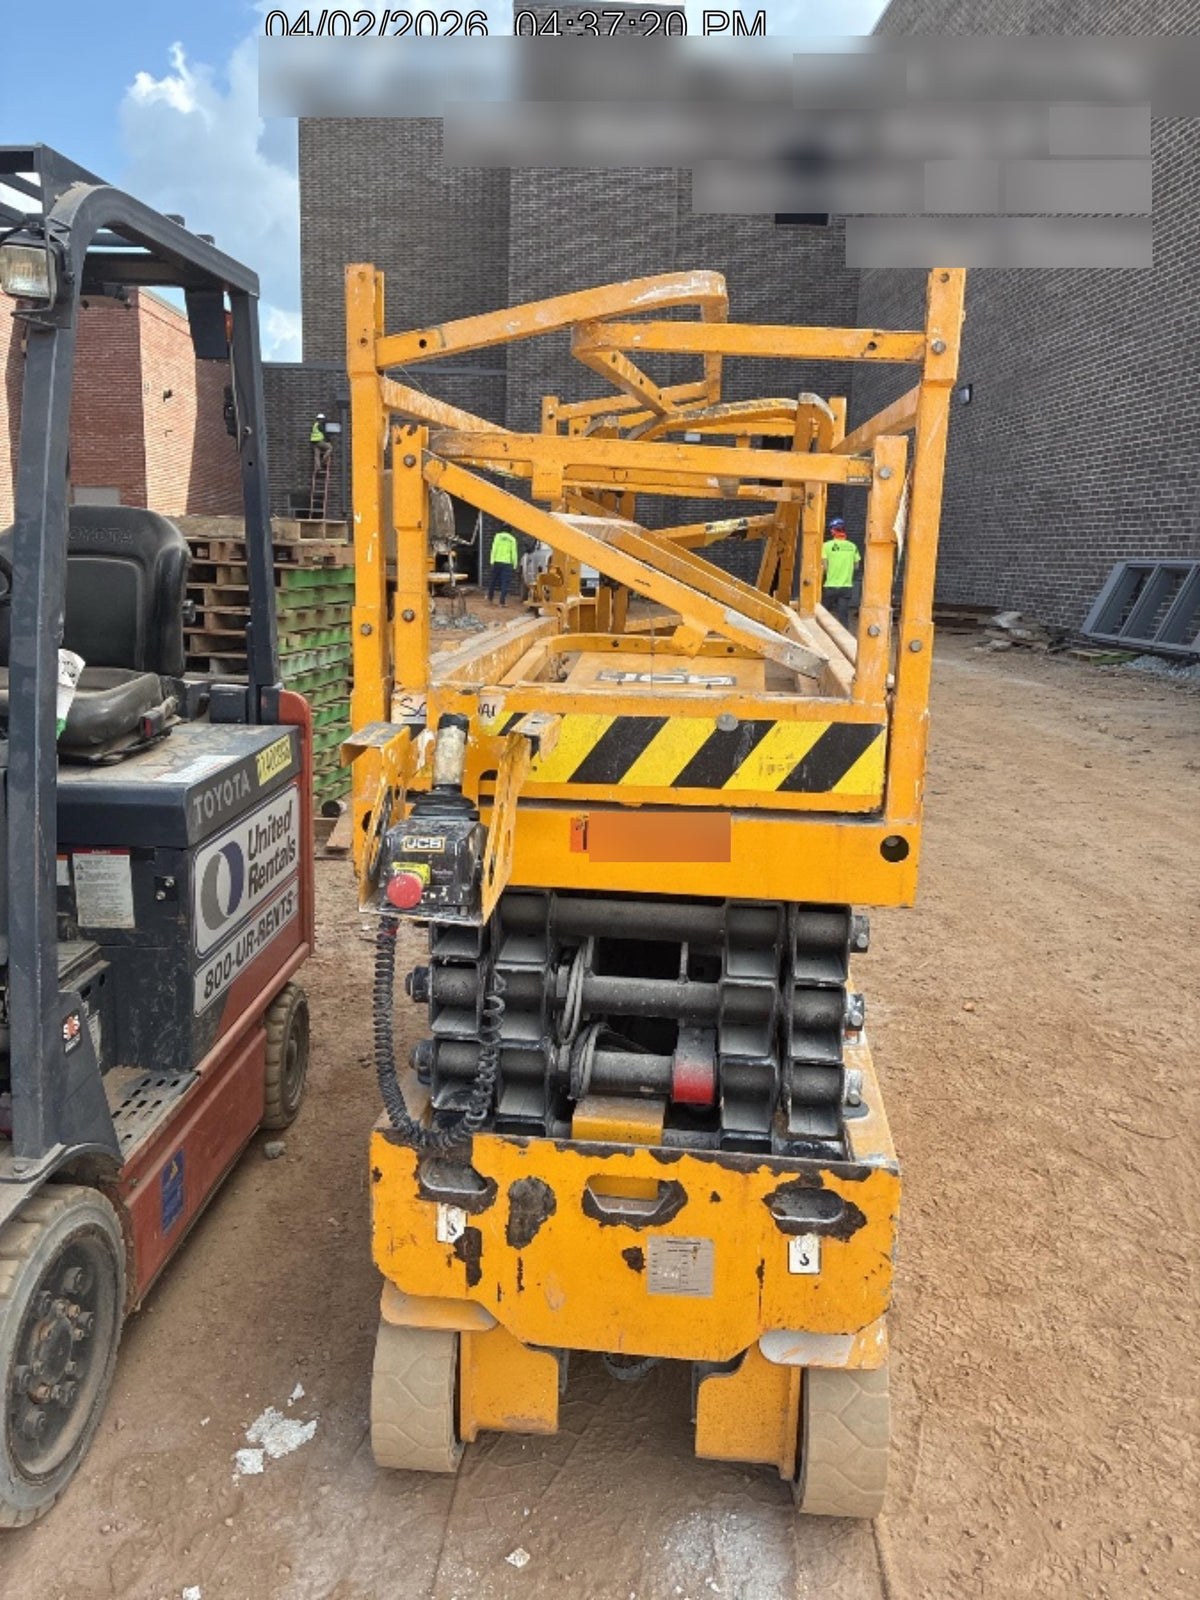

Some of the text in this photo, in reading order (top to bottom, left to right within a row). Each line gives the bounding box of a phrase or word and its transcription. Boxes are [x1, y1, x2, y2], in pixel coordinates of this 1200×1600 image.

[193, 769, 251, 824] TOYOTA
[248, 799, 293, 861] United
[405, 837, 442, 850] JCB
[248, 838, 297, 899] Rentals
[203, 890, 294, 1000] 800-UR-RENTS
